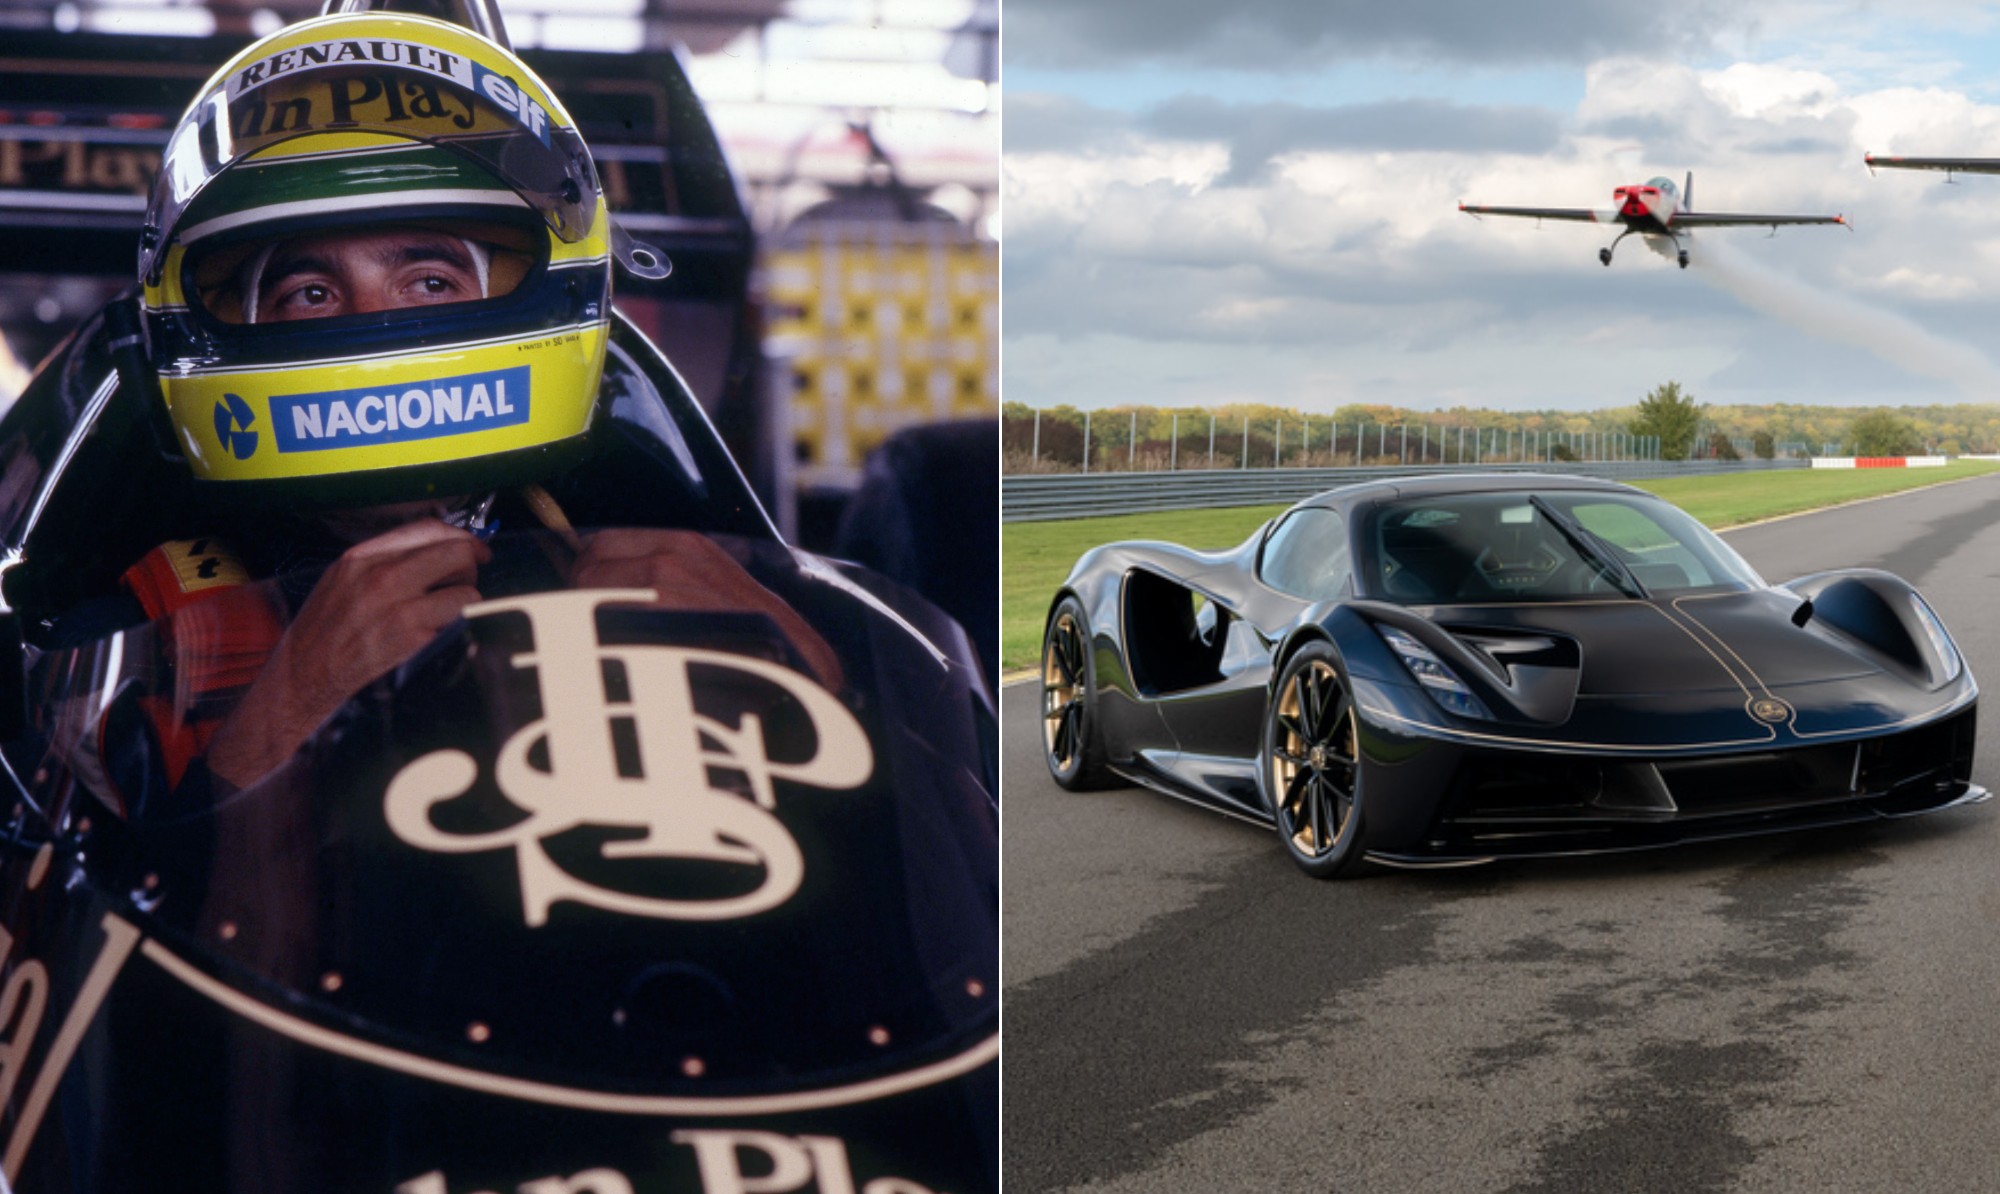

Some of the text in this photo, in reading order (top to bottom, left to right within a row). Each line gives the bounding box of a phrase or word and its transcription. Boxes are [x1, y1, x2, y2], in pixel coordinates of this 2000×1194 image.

[236, 40, 458, 95] RENAULT
[481, 73, 547, 139] elf
[291, 379, 514, 440] NACIONAL
